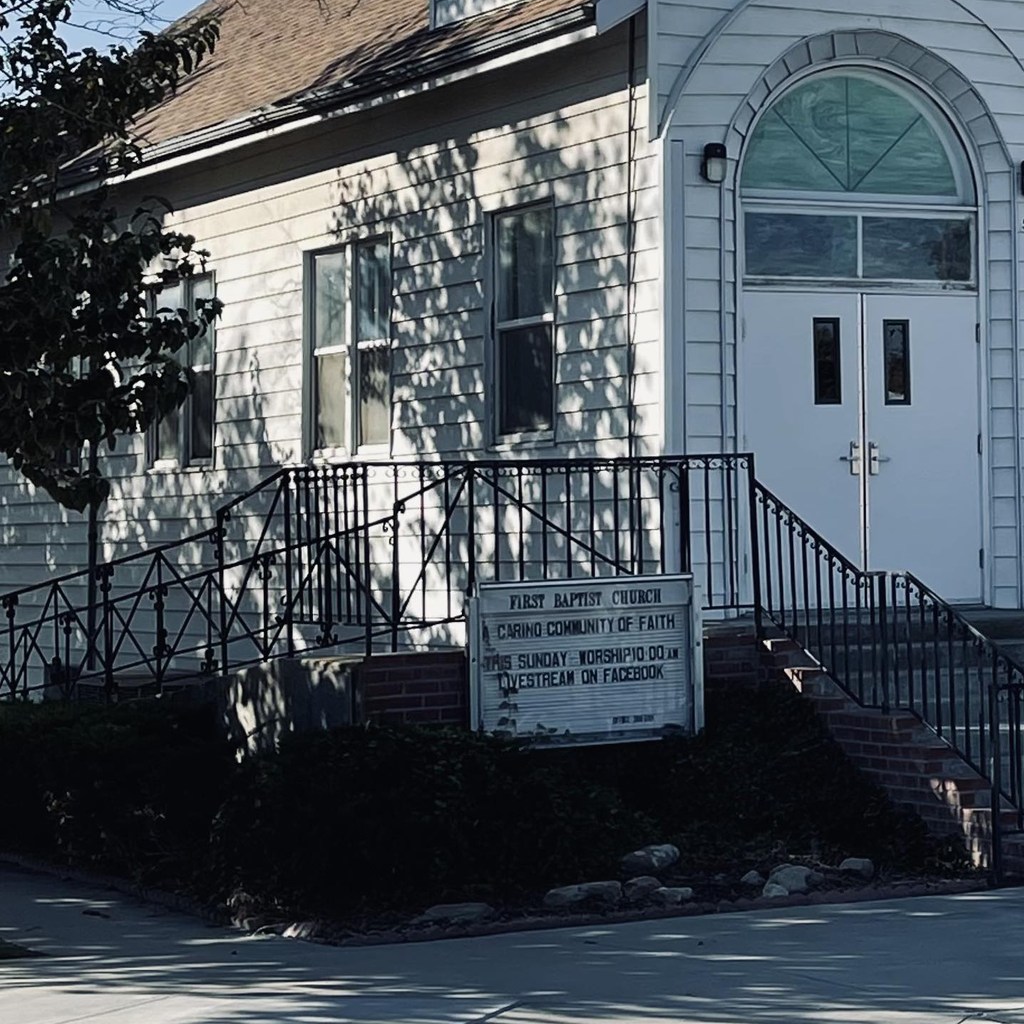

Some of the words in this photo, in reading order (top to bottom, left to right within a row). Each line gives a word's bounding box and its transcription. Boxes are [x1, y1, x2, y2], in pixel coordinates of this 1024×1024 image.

[509, 593, 545, 610] FIRST
[553, 591, 602, 608] BAPTIST
[612, 588, 662, 605] CHURCH
[546, 617, 614, 636] COMMUNITY
[617, 616, 633, 632] OF
[639, 613, 675, 631] FAITH
[482, 654, 512, 671] THIS
[518, 650, 568, 669] SUNDAY
[581, 668, 598, 685] ON
[603, 663, 665, 684] FACEBOOK
